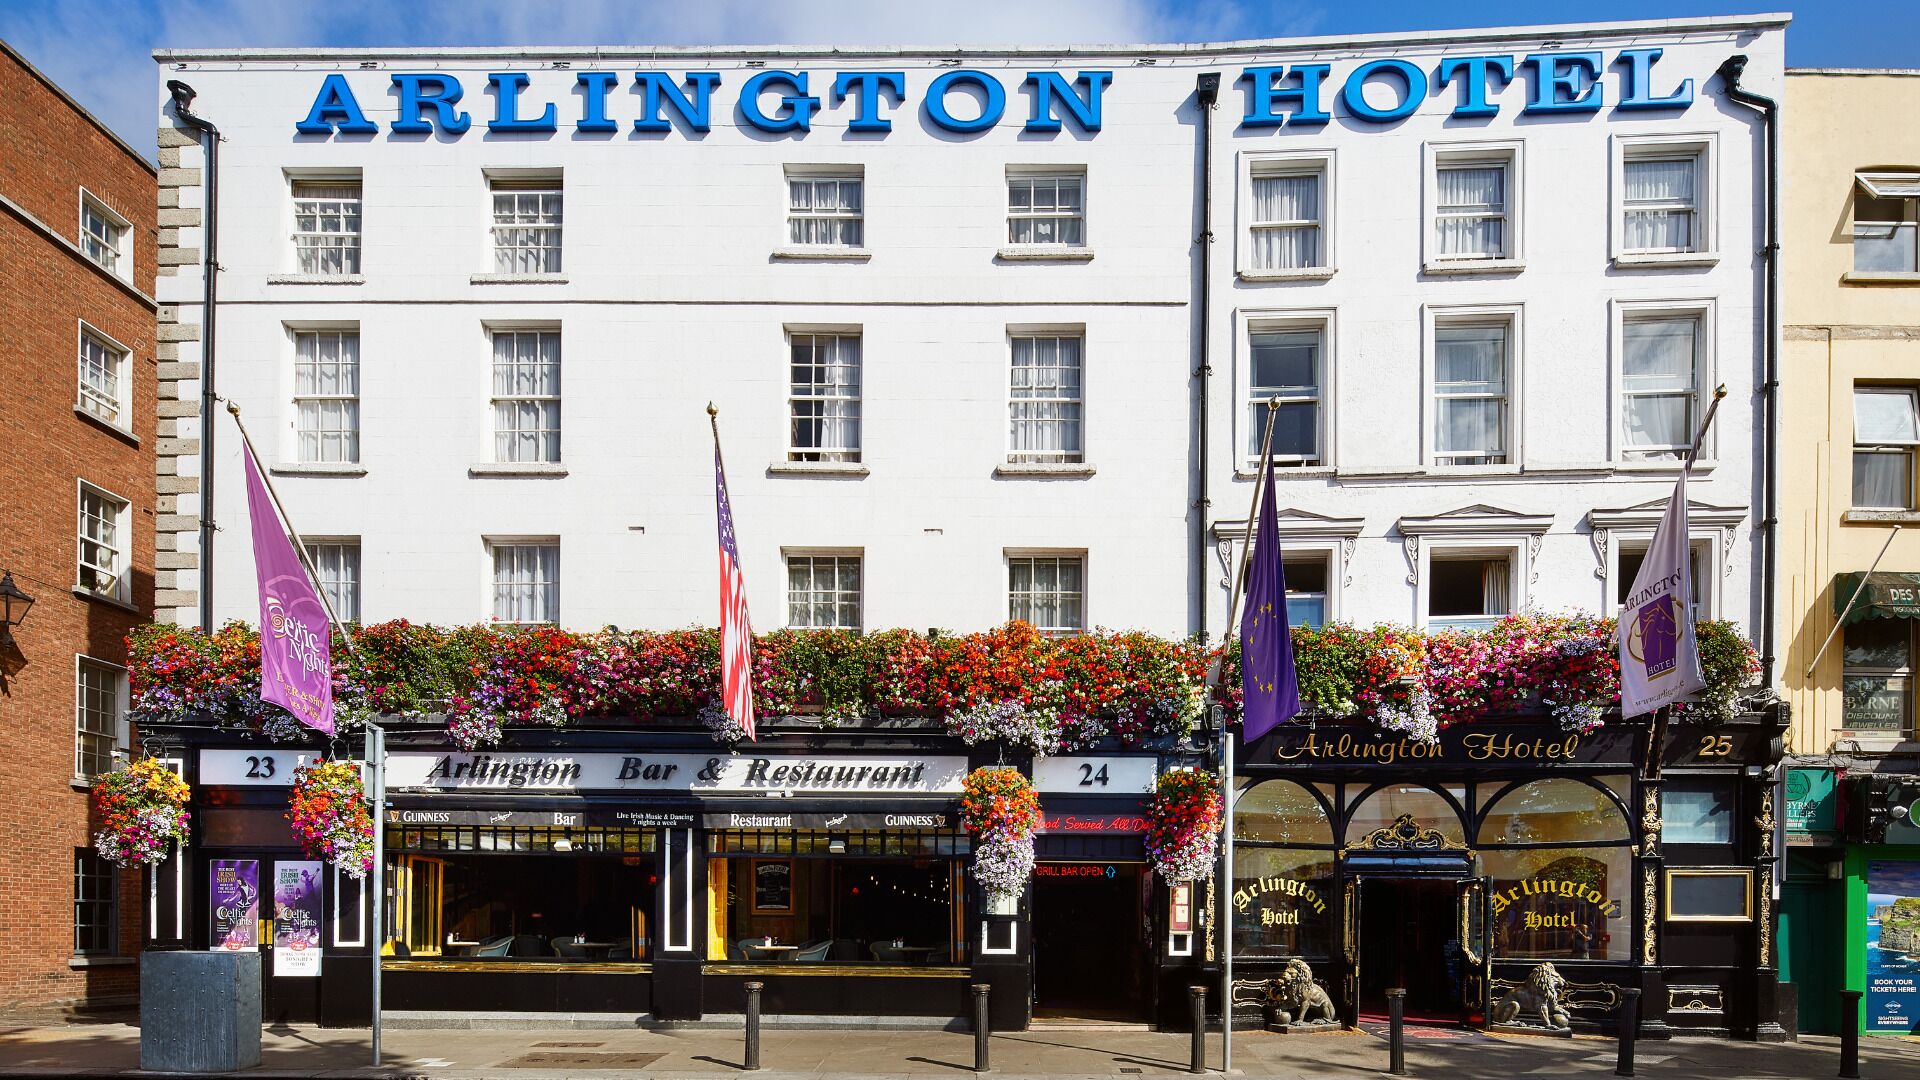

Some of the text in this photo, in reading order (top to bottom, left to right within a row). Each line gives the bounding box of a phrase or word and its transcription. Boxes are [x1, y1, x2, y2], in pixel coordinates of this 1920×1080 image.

[296, 48, 1694, 135] ARLINGTON HOTEL
[1624, 568, 1682, 613] ARLINGTON
[1890, 588, 1914, 601] DES
[267, 597, 320, 653] Celtic
[289, 638, 329, 681] Nights
[1845, 696, 1899, 710] BYRNE
[1846, 712, 1901, 720] DISCOUNT
[1278, 732, 1579, 765] Arlington Hotel
[1699, 735, 1733, 756] 25
[245, 756, 275, 778] 23
[426, 755, 925, 786] Arlington Bar & Restaurant
[1079, 763, 1109, 786] 24
[403, 811, 450, 822] GUINNESS
[553, 812, 576, 825] Bar
[670, 813, 694, 821] Dancing
[730, 814, 792, 827] Restaurant
[884, 815, 933, 826] GUINNESS
[1039, 817, 1060, 829] ood
[1064, 816, 1104, 831] Served
[1106, 817, 1129, 831] All
[1036, 866, 1104, 876] GRILL BAR OPEN
[1233, 875, 1327, 915] Arlington
[1492, 877, 1616, 916] Arlington
[216, 906, 246, 920] Celtic
[281, 907, 310, 921] Celtic
[1260, 907, 1300, 928] Hotel
[229, 917, 253, 926] Nights
[293, 918, 317, 927] Nights
[1523, 911, 1577, 931] Hotel
